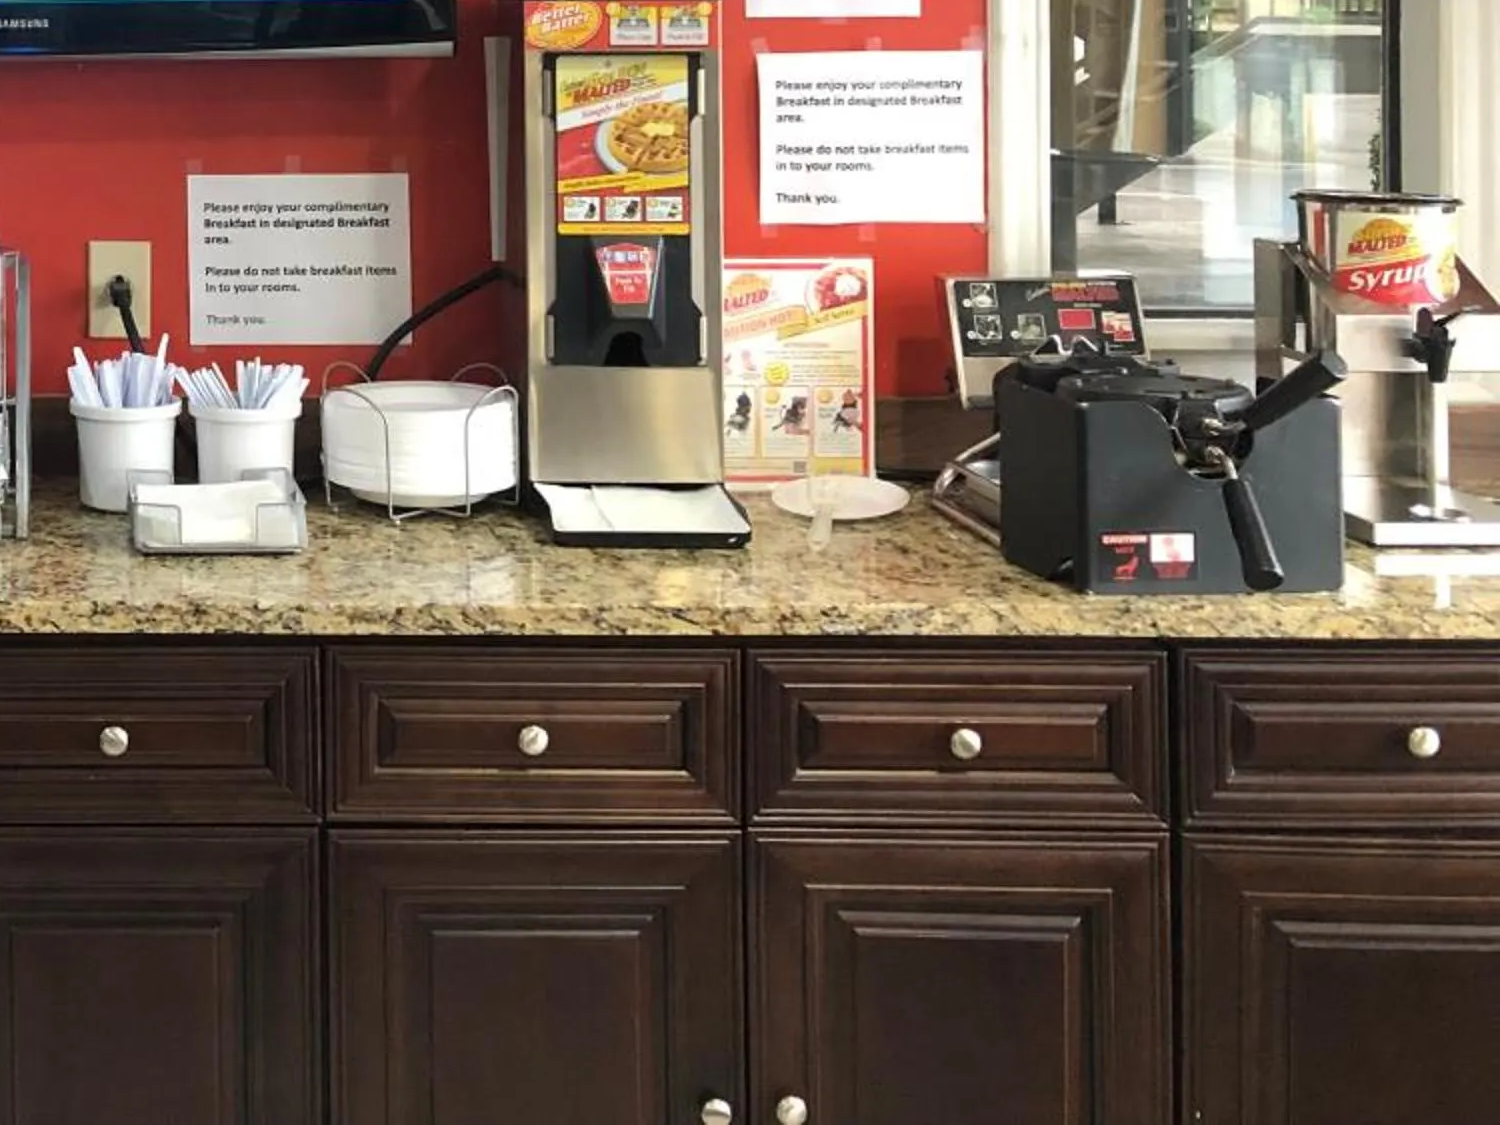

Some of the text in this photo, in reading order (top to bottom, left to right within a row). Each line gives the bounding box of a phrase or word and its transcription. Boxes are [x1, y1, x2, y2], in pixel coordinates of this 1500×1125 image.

[775, 79, 962, 92] Please enjoy your complimentary
[776, 95, 963, 108] Breakfast in designated Breakfast
[775, 113, 804, 123] area.
[776, 143, 969, 155] Please do not take breakfast items
[775, 160, 875, 173] in to your rooms.
[776, 192, 812, 203] Thank
[203, 201, 389, 215] Please enjoy your complimentary
[204, 217, 390, 230] Breakfast in designated Breakfast
[1347, 233, 1407, 256] MALTED
[205, 265, 397, 276] Please do not take breakfast items
[219, 282, 231, 293] to
[234, 283, 259, 295] your
[262, 283, 301, 293] rooms.
[206, 315, 240, 325] Thank
